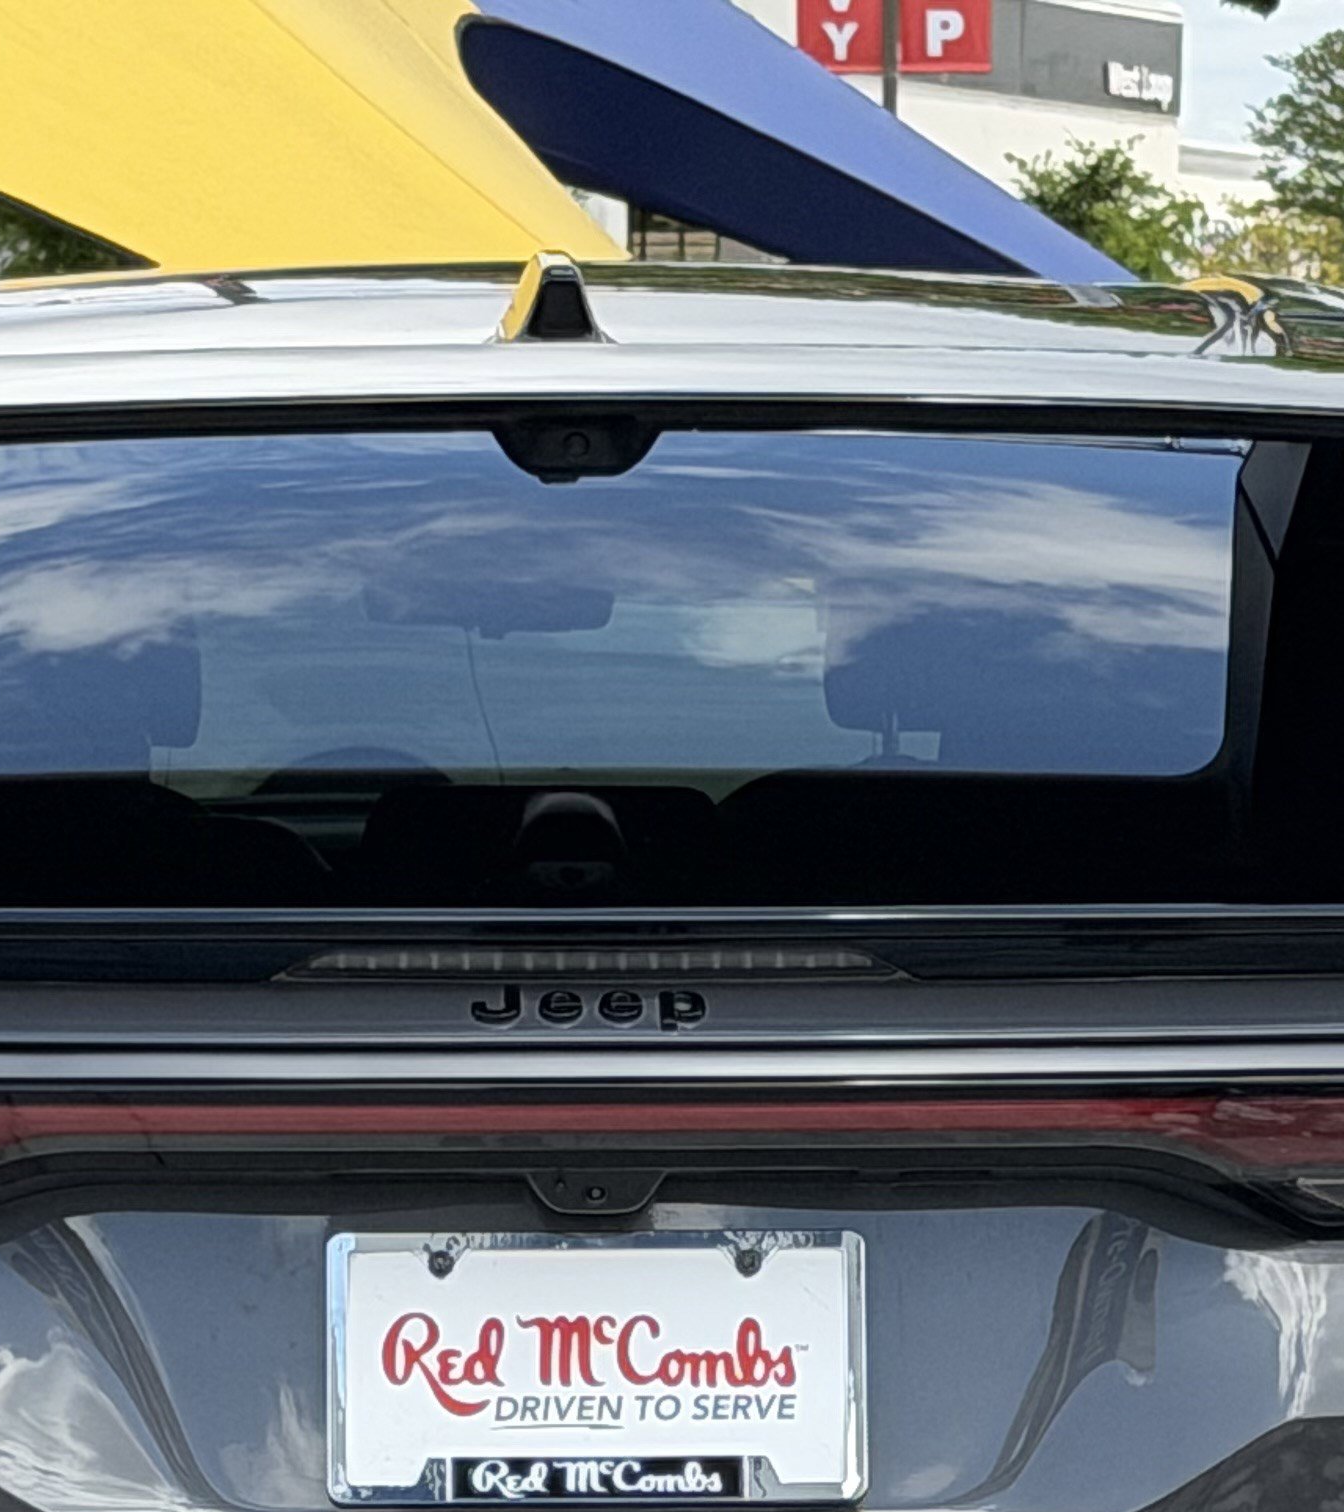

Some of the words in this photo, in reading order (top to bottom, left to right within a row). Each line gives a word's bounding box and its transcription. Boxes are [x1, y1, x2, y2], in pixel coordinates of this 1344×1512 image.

[470, 984, 707, 1032] Jeep
[381, 1312, 505, 1416] Red
[516, 1314, 798, 1389] McCombs
[494, 1396, 624, 1422] DRIVEN
[634, 1396, 681, 1420] TO
[691, 1394, 798, 1420] SERVE
[471, 1460, 549, 1499] Red
[554, 1460, 724, 1494] McCombs
